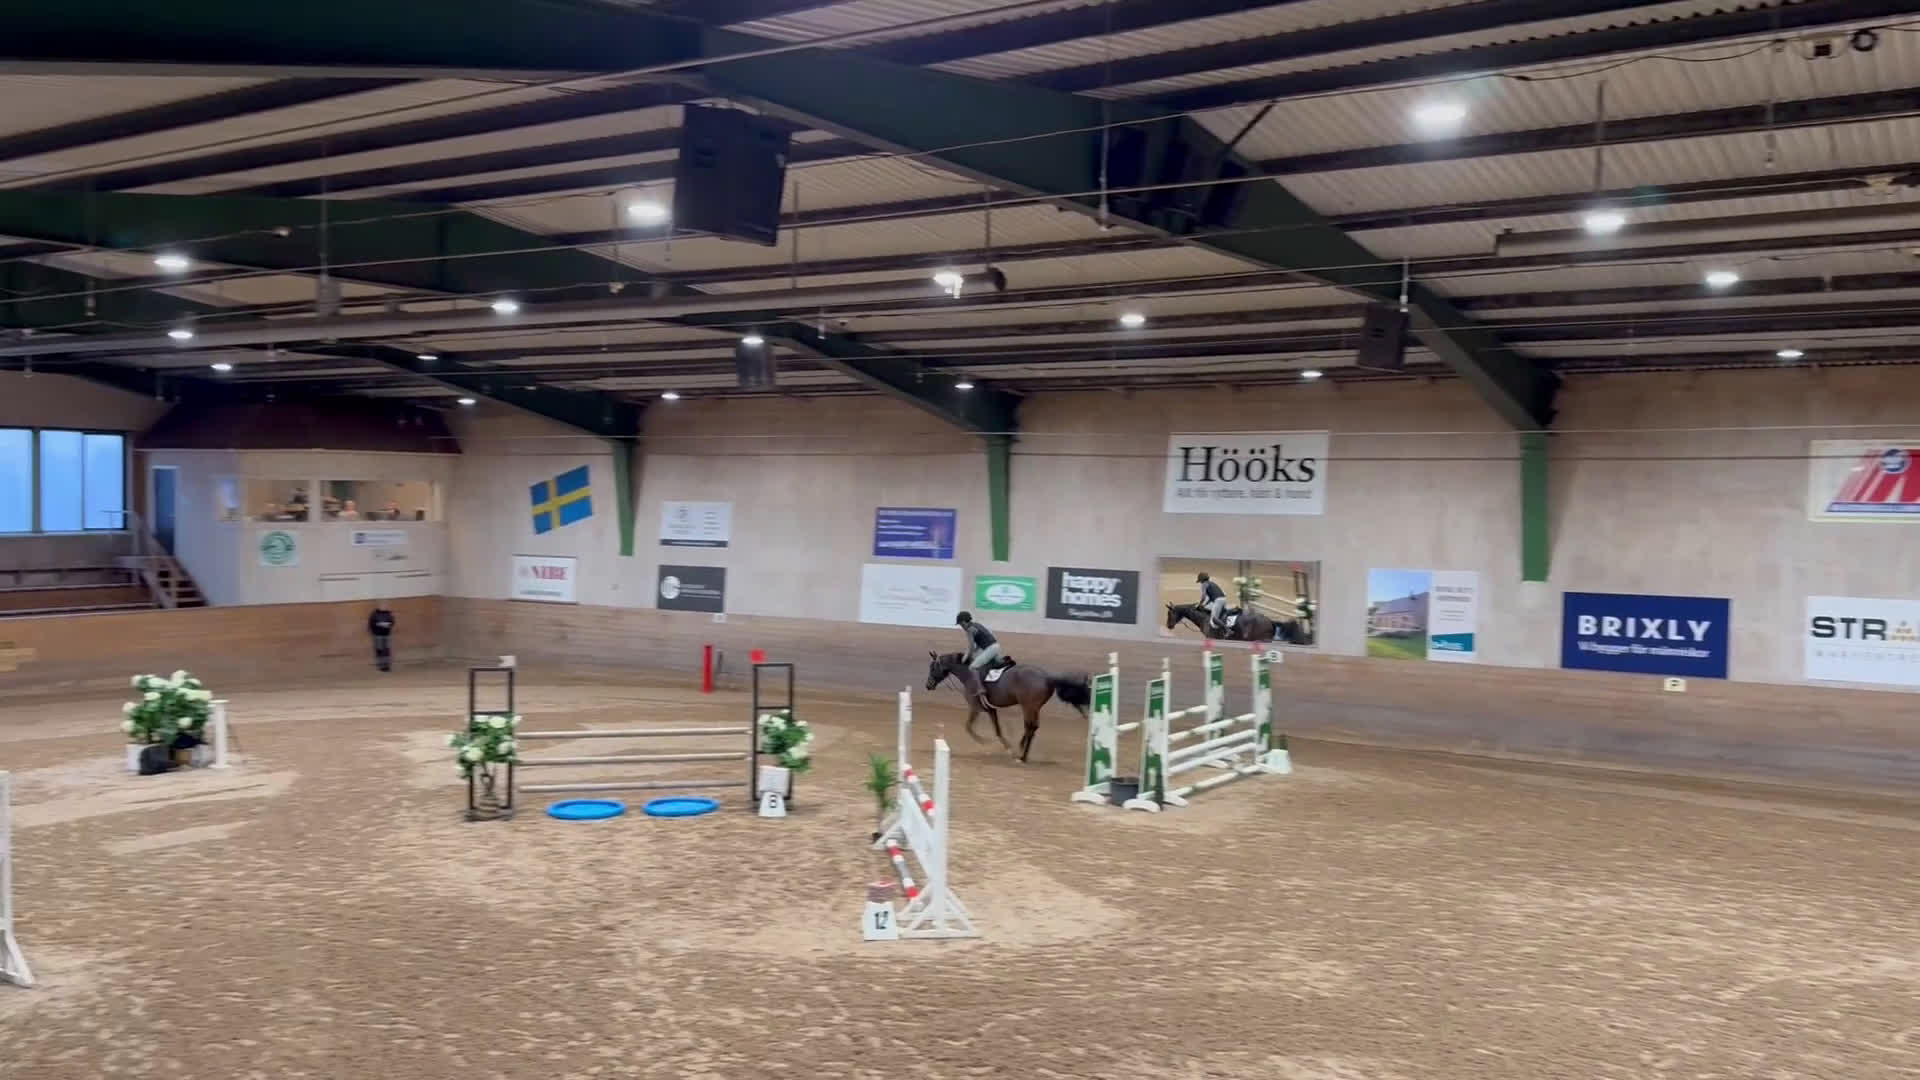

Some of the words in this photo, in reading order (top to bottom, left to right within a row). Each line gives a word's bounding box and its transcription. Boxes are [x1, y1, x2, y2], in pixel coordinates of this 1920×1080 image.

[1175, 444, 1316, 483] Hööks
[1062, 571, 1122, 594] happy
[1061, 588, 1122, 608] homes
[1577, 614, 1712, 642] BRIXLY
[874, 910, 889, 930] 12
